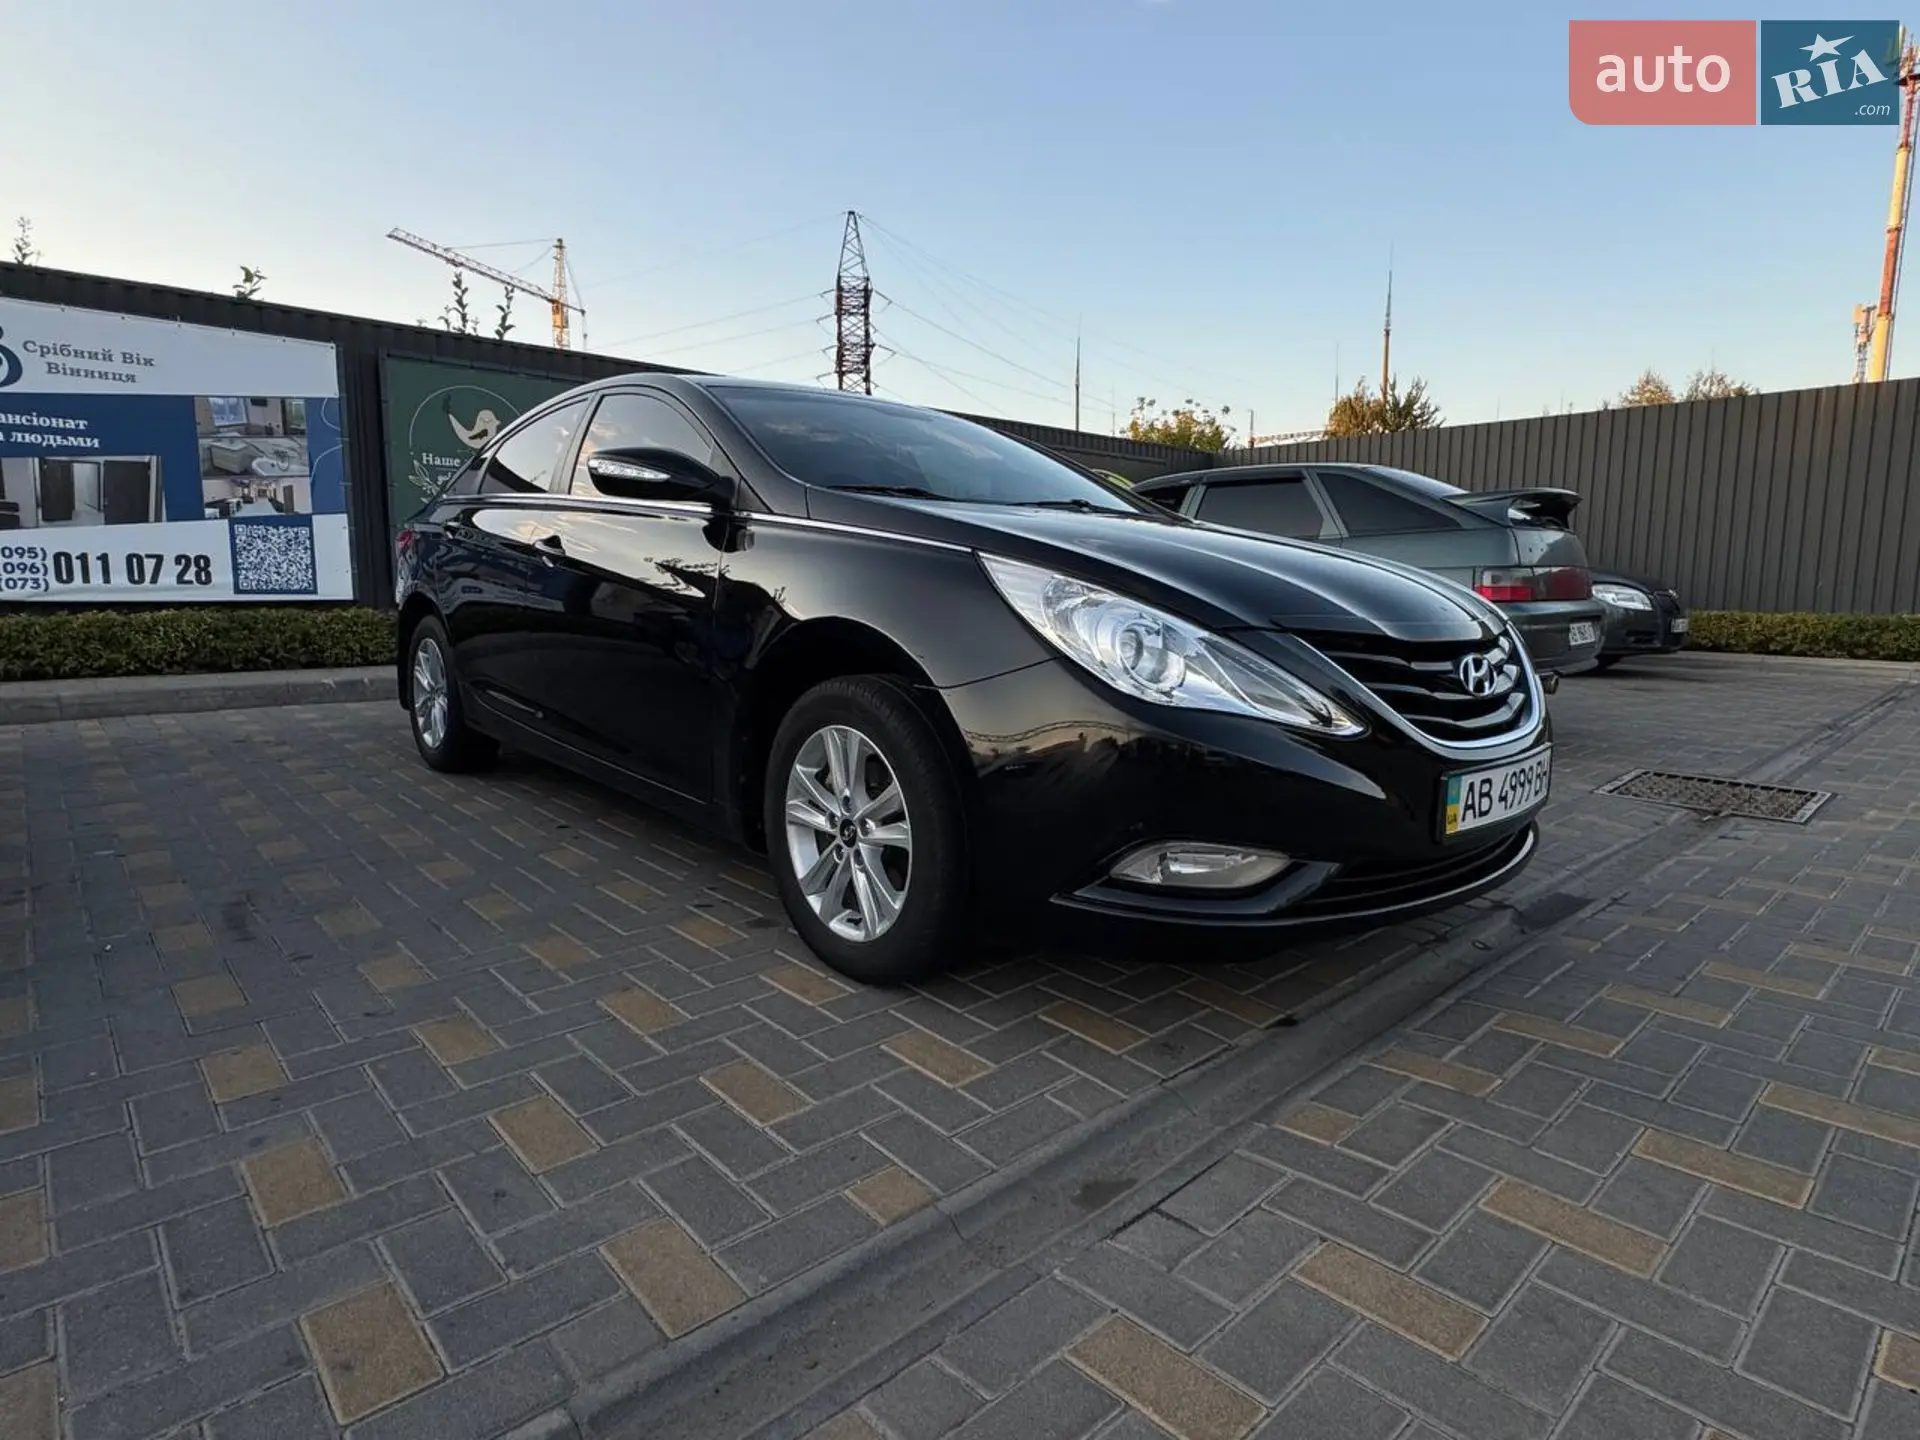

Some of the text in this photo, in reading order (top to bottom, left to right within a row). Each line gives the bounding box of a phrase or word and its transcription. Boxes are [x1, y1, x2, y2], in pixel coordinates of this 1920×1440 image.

[22, 339, 155, 367] Срібний Вік
[45, 361, 137, 384] Вінниця
[10, 431, 100, 448] людьми
[422, 453, 461, 467] Наше
[0, 561, 49, 577] 096)
[52, 551, 213, 586] 011 07 28
[1461, 778, 1493, 822] AB
[1498, 766, 1533, 810] 4999
